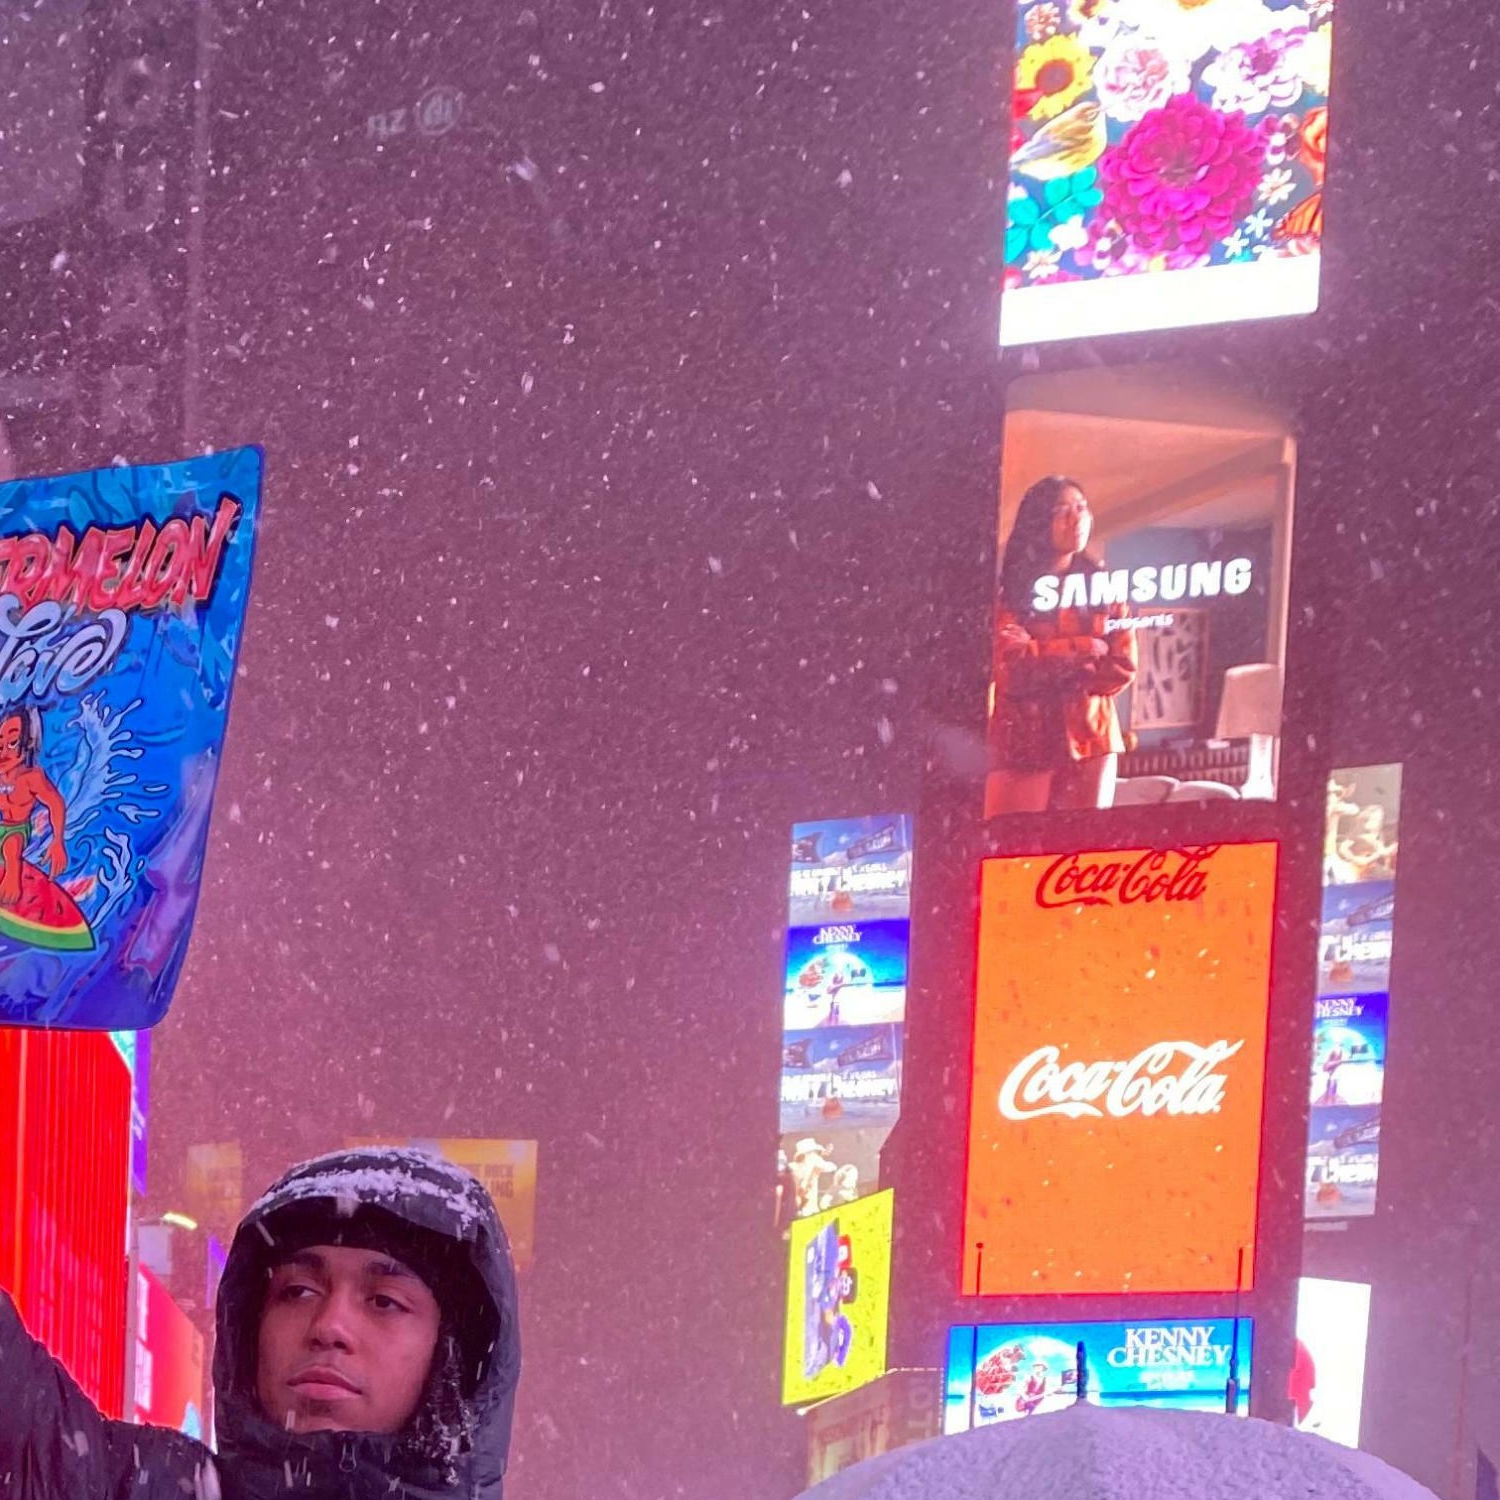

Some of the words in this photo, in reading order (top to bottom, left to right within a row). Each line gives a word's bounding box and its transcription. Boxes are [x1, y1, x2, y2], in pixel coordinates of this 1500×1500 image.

[1032, 558, 1252, 612] SAMSUNG
[1103, 614, 1174, 635] presents
[1035, 845, 1221, 909] Coca-Cola
[998, 1040, 1245, 1121] Coca-Cola
[1106, 1344, 1231, 1368] CHESNEY
[1125, 1326, 1216, 1347] KENNY
